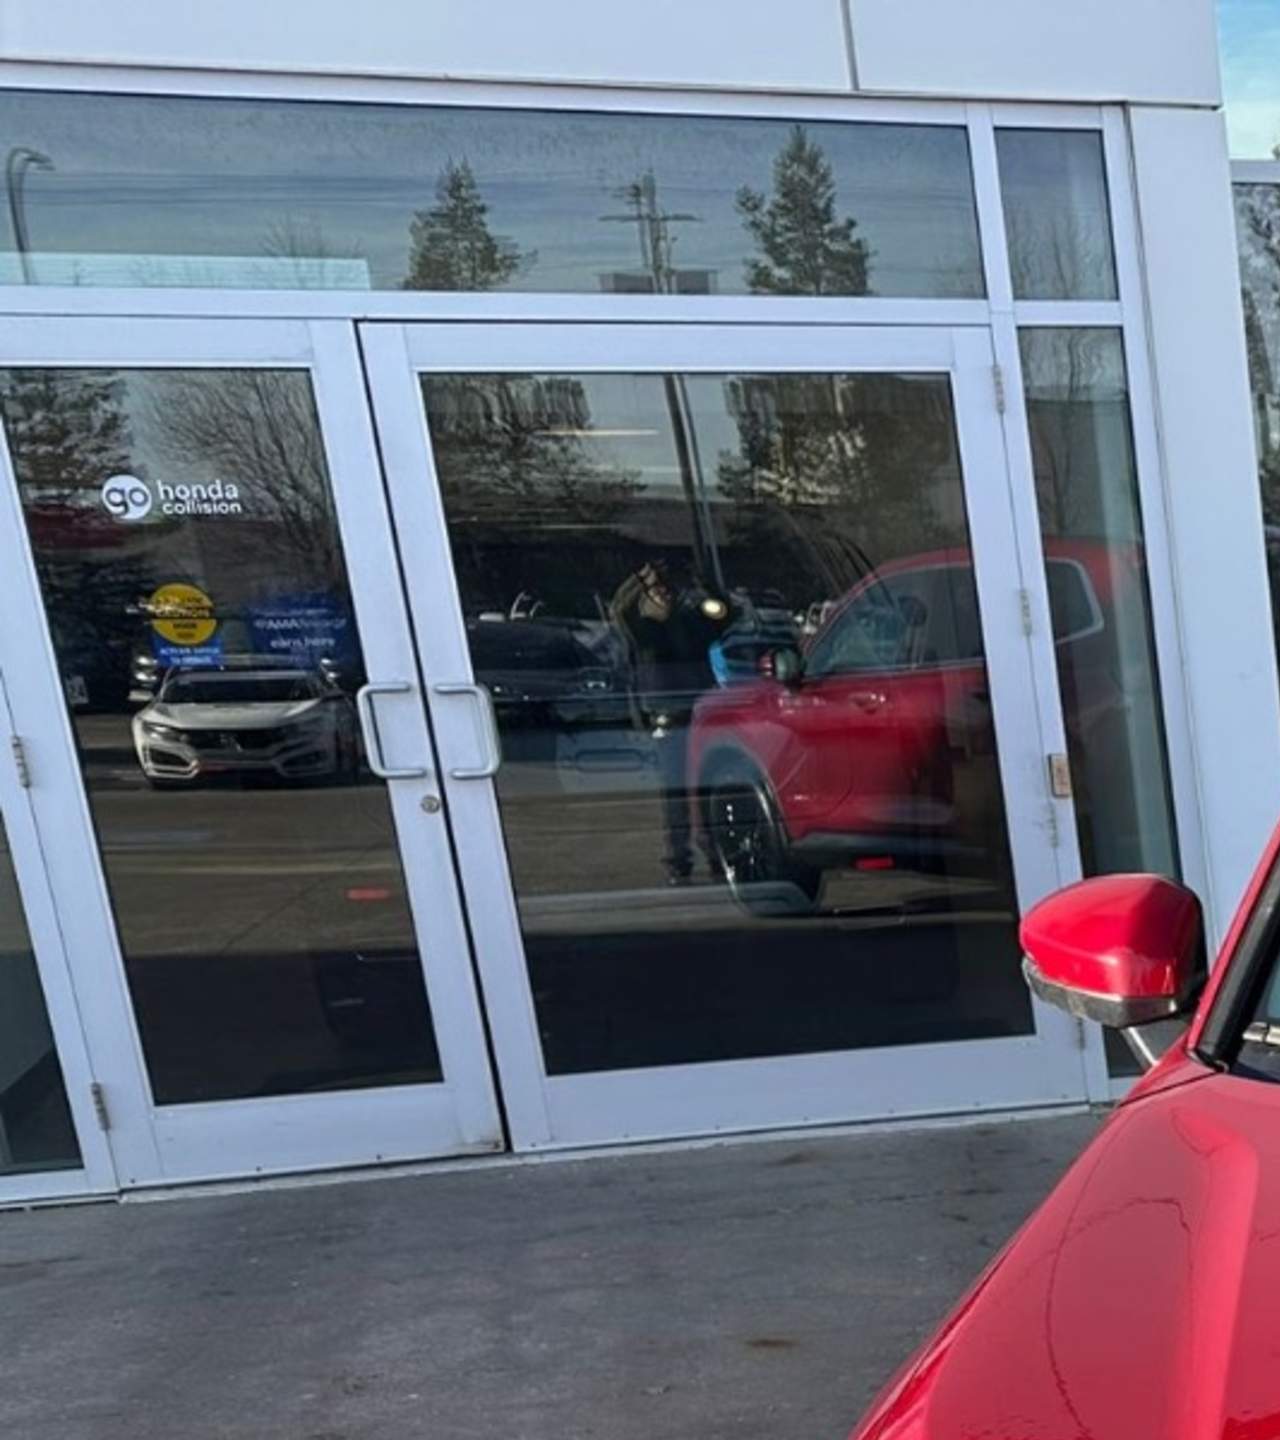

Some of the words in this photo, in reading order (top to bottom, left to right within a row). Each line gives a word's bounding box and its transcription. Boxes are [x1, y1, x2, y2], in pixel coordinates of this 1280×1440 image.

[156, 479, 239, 500] honda
[104, 485, 149, 516] go
[161, 500, 242, 514] collision
